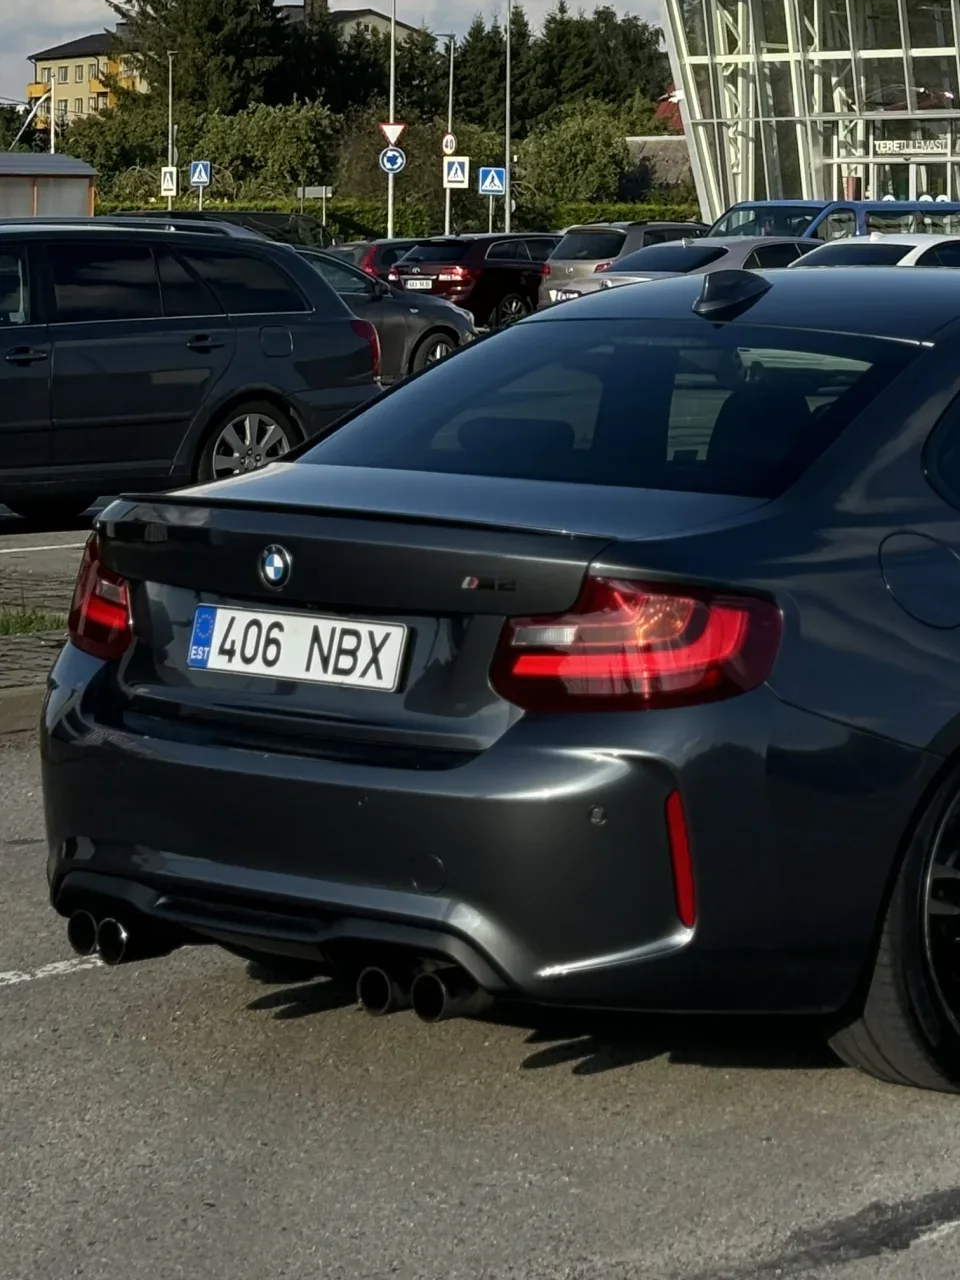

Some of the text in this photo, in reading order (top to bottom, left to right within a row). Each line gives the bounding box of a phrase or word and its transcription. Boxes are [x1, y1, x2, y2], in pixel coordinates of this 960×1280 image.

[444, 138, 454, 150] 40
[191, 646, 210, 660] EST
[217, 615, 392, 680] 406 NBX
